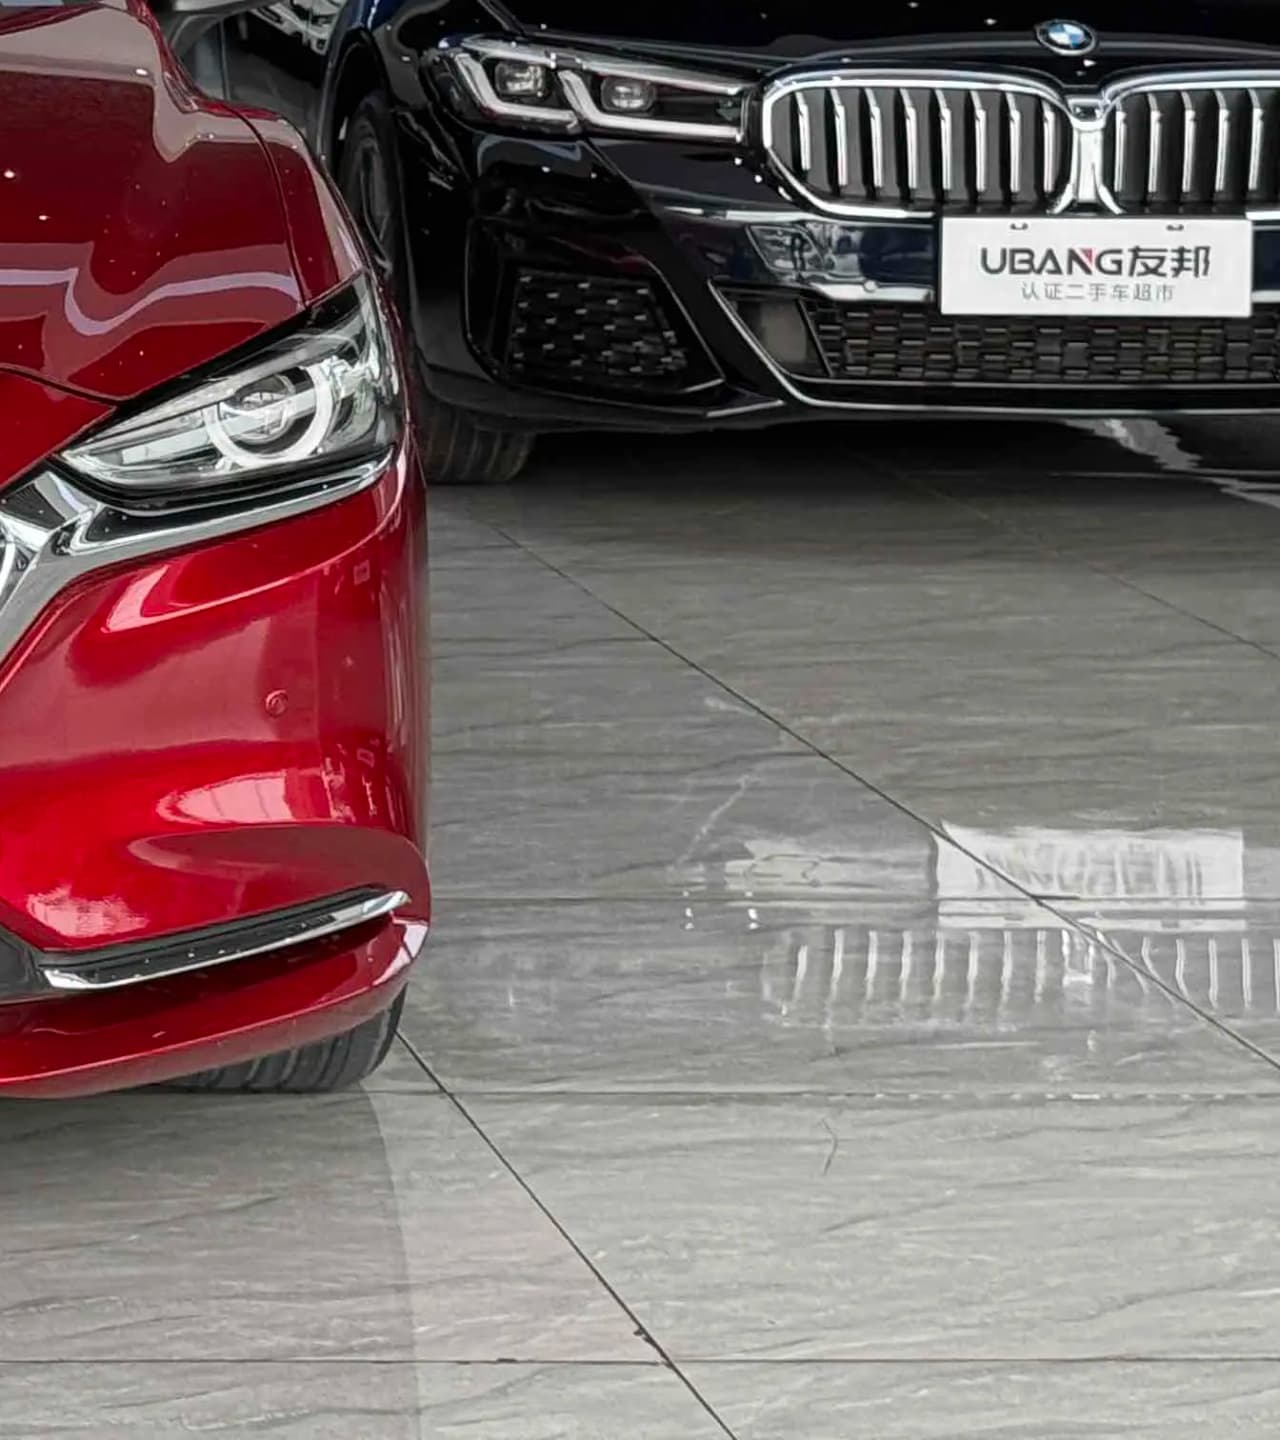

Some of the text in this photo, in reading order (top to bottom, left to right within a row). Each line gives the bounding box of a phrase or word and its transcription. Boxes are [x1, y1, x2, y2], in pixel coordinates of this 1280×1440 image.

[981, 246, 1211, 278] UBANG友邦
[1022, 281, 1175, 302] 认证二手车超市
